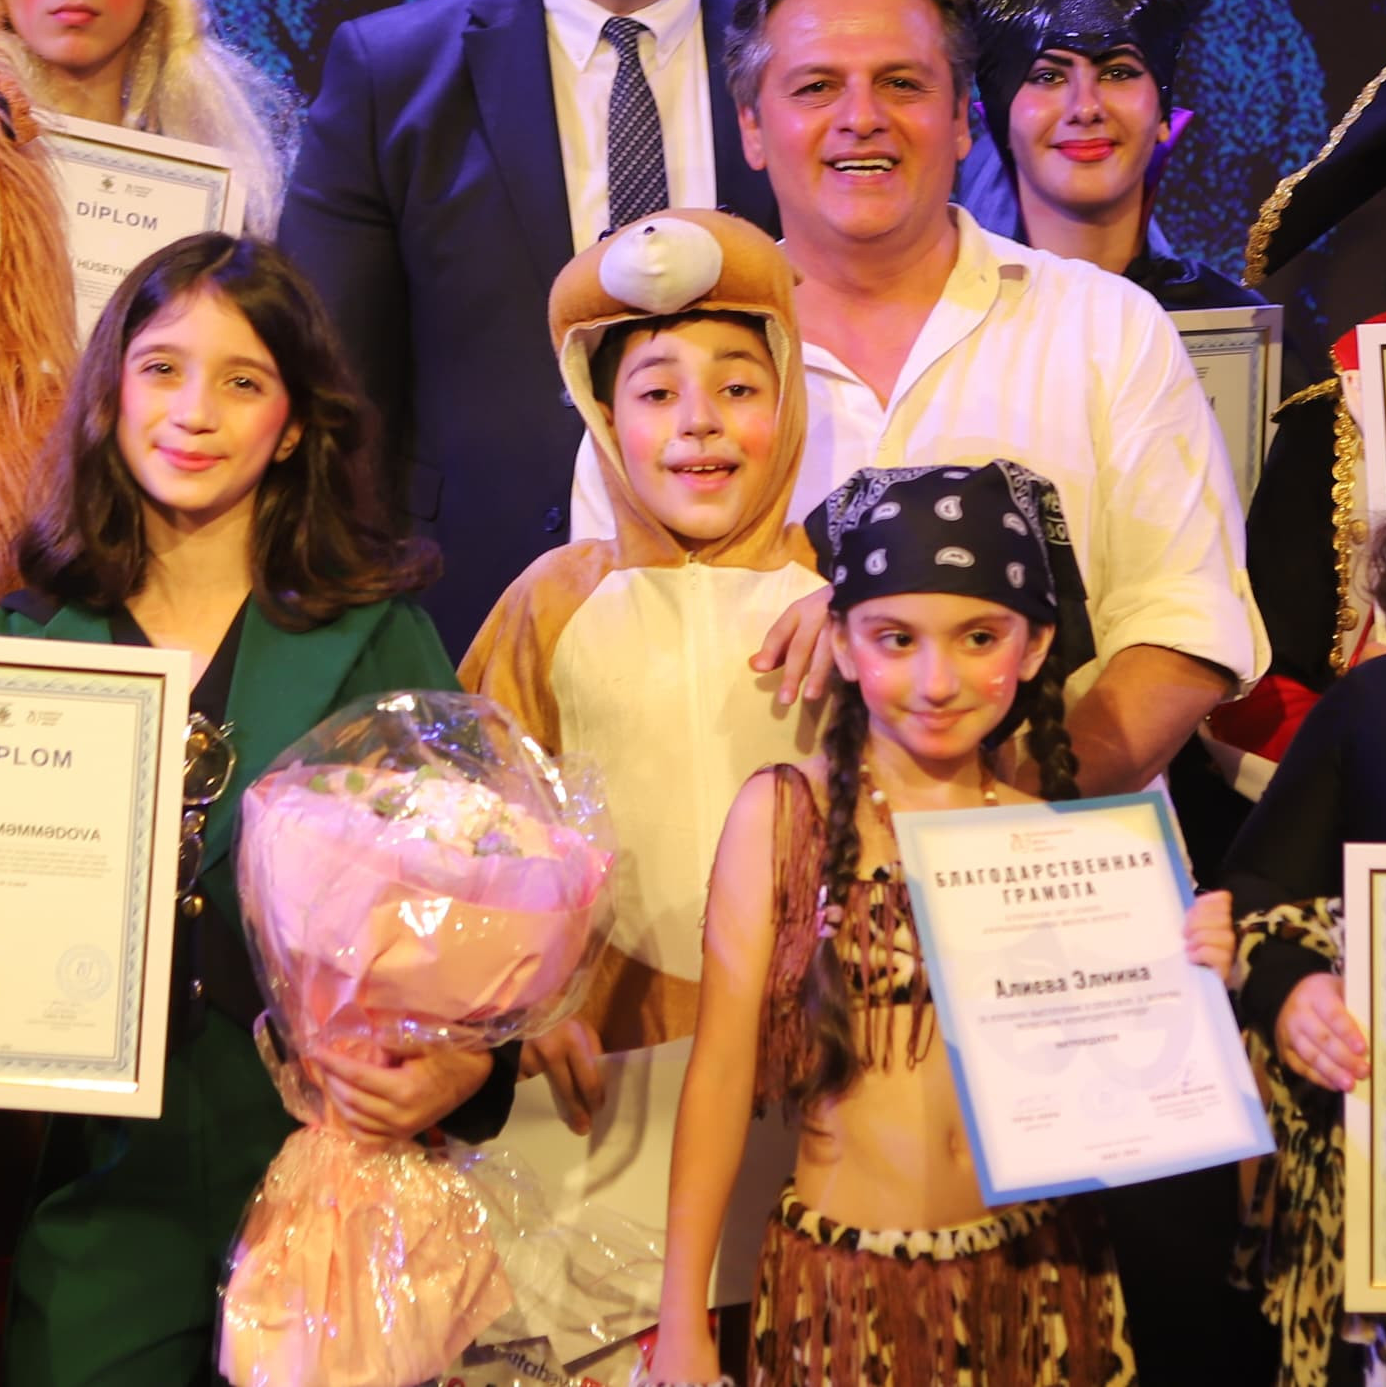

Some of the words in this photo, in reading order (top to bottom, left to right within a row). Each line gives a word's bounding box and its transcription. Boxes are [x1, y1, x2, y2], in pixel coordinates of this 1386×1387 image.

[76, 200, 159, 232] DİPLOM
[934, 850, 1155, 889] БЛАГОДАРСТВЕННАЯ
[1002, 880, 1098, 906] ГРАМОТА
[994, 977, 1068, 1000] Алиева
